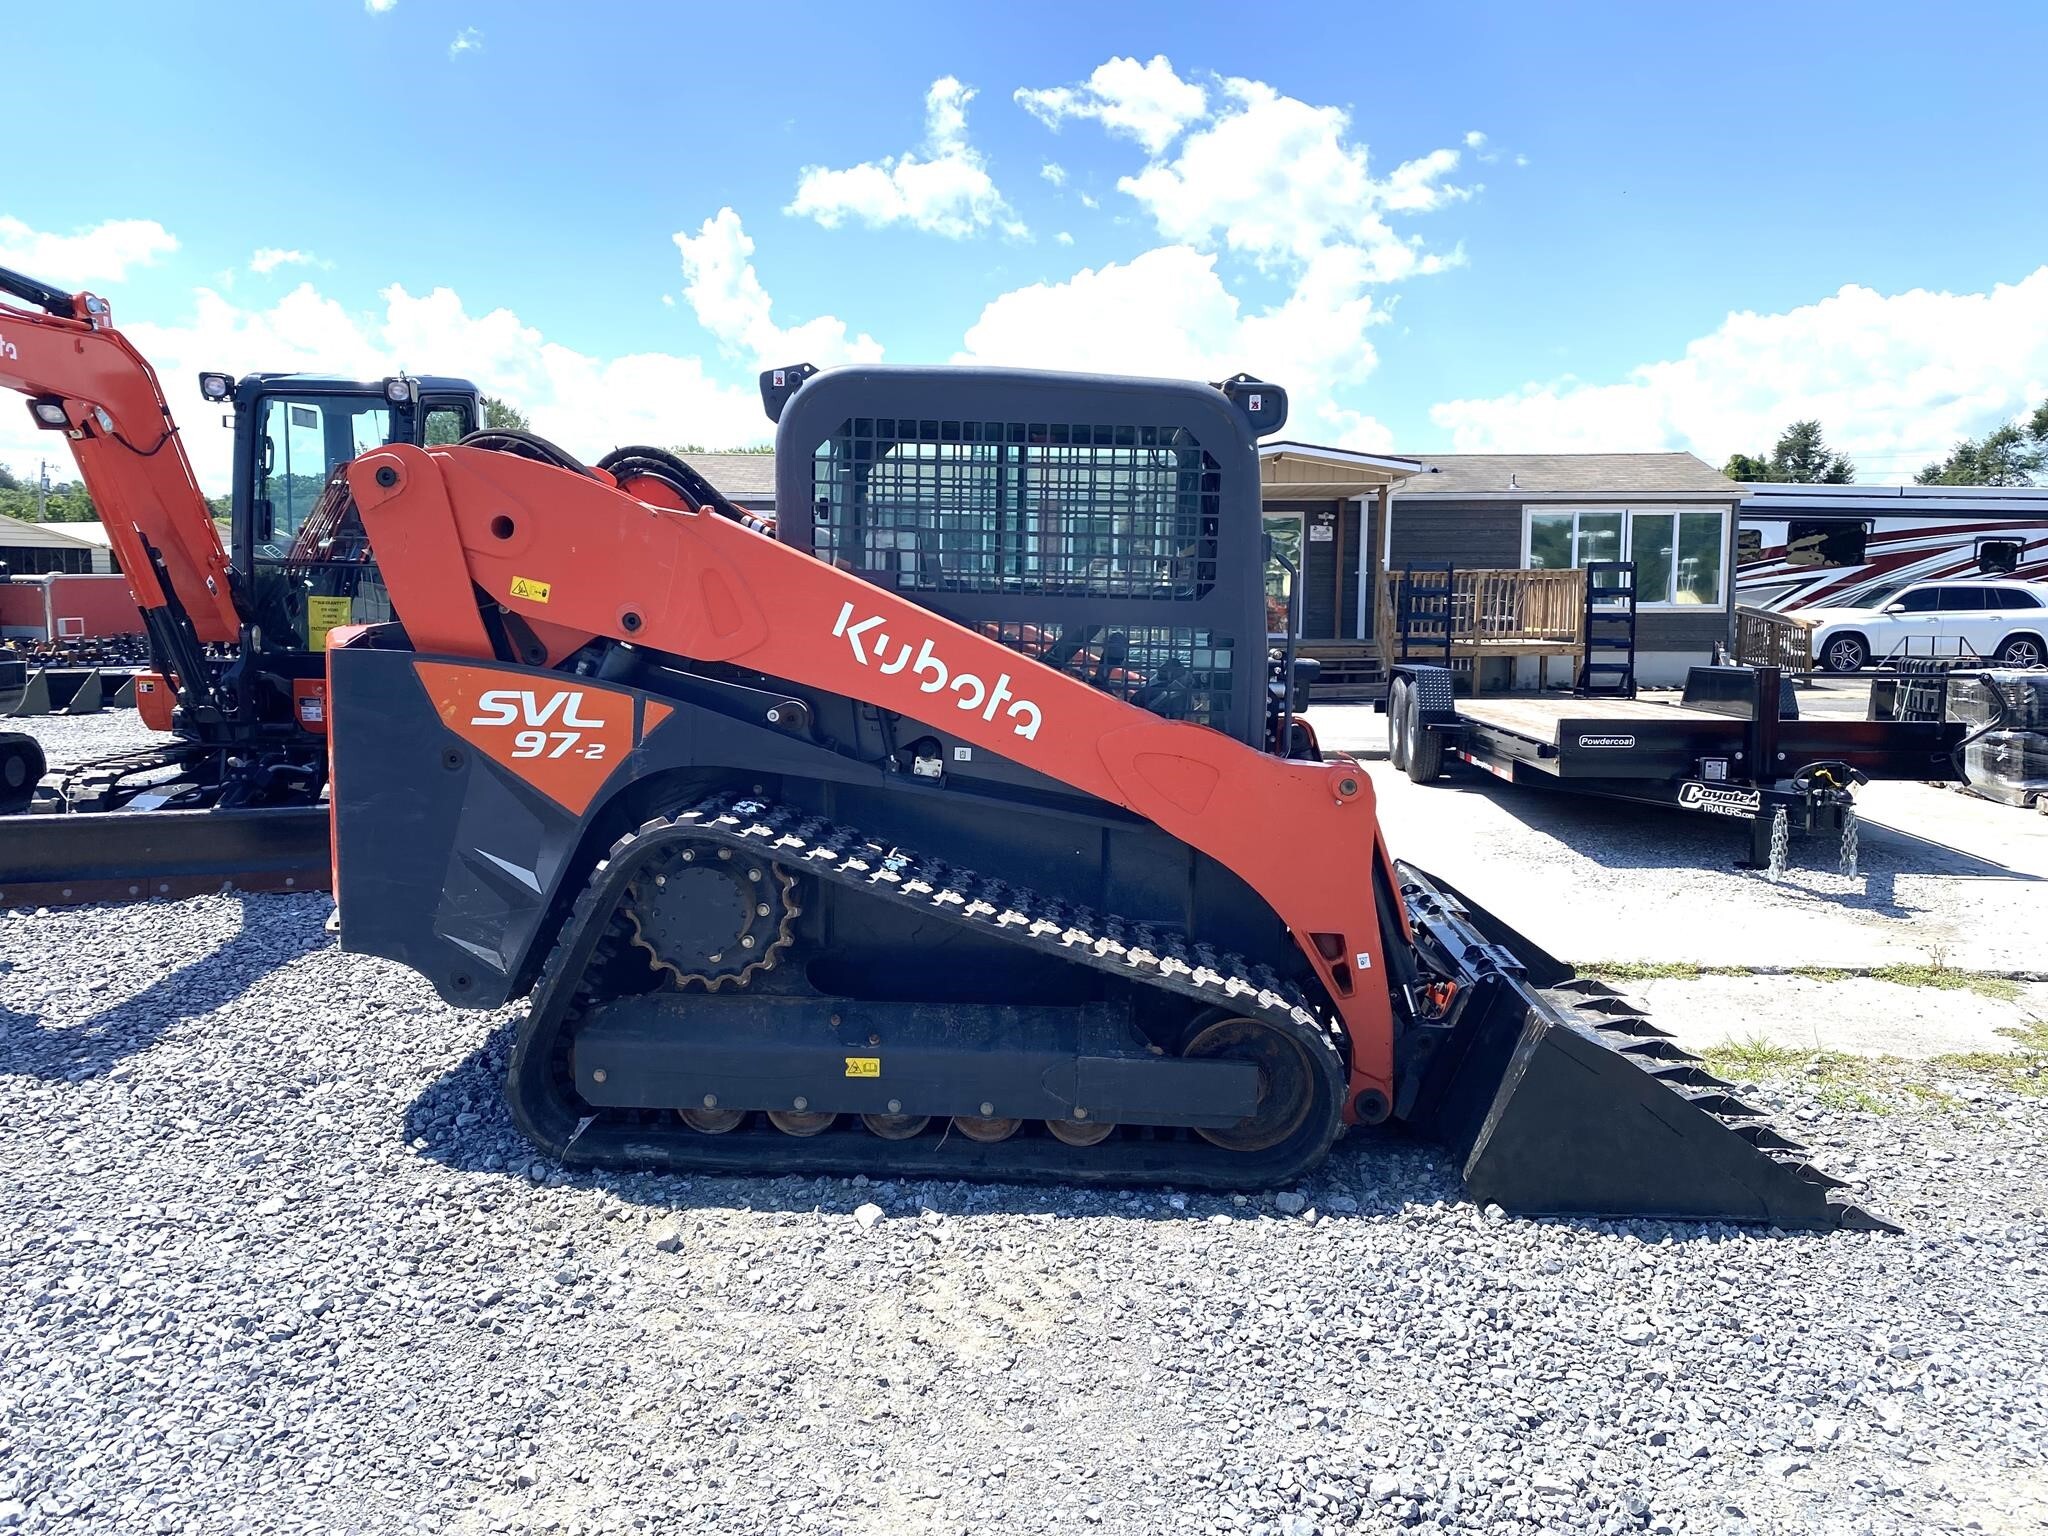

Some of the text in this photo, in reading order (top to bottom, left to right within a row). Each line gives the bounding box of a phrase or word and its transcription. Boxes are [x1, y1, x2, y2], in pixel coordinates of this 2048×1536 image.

[832, 601, 1042, 741] Kubota
[470, 690, 605, 728] SVL
[511, 731, 606, 759] 97-2
[1581, 737, 1633, 745] Powdercoat
[1679, 783, 1751, 805] Coyote
[1703, 803, 1756, 819] TRAILERS.com
